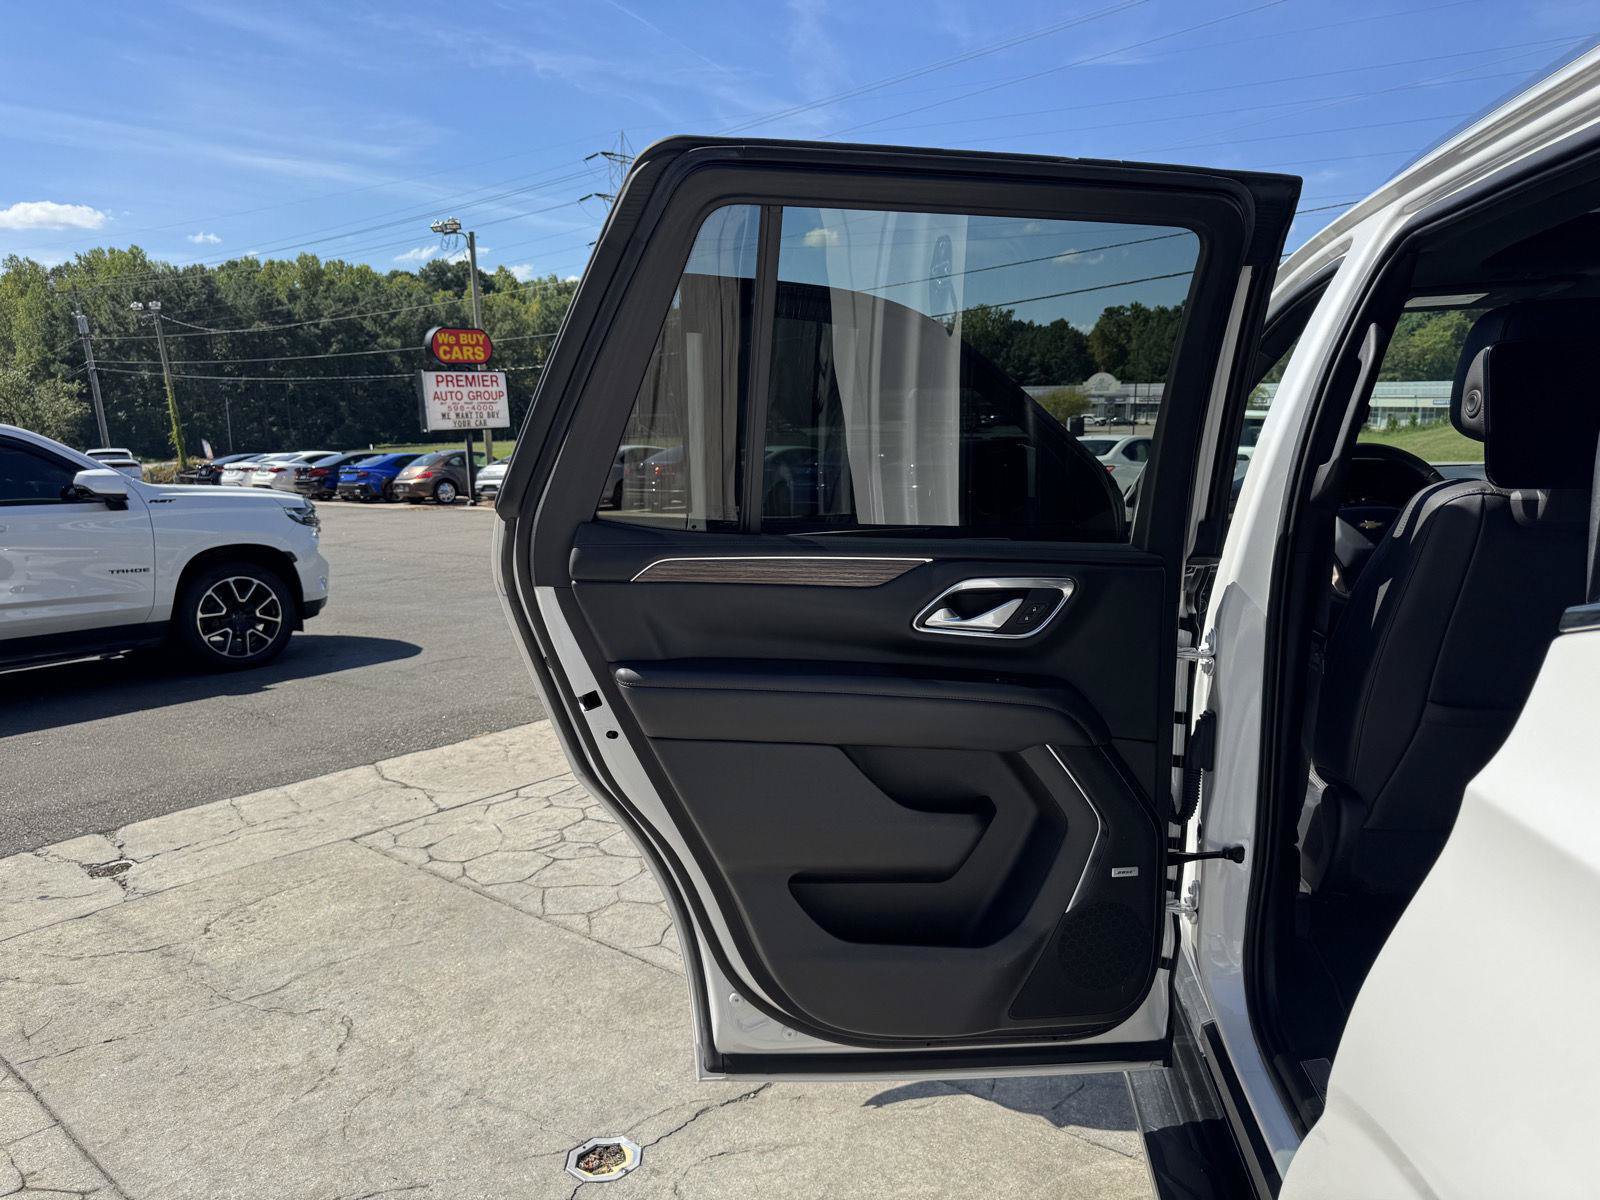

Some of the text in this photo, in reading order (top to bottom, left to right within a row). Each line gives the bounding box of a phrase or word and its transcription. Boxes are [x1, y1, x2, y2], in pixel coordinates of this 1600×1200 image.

[438, 333, 485, 345] We BUY
[439, 346, 485, 360] CARS
[435, 374, 500, 388] PREMIER
[433, 390, 505, 402] AUTO GROUP
[487, 410, 500, 419] BUY
[108, 567, 150, 575] TAHOE
